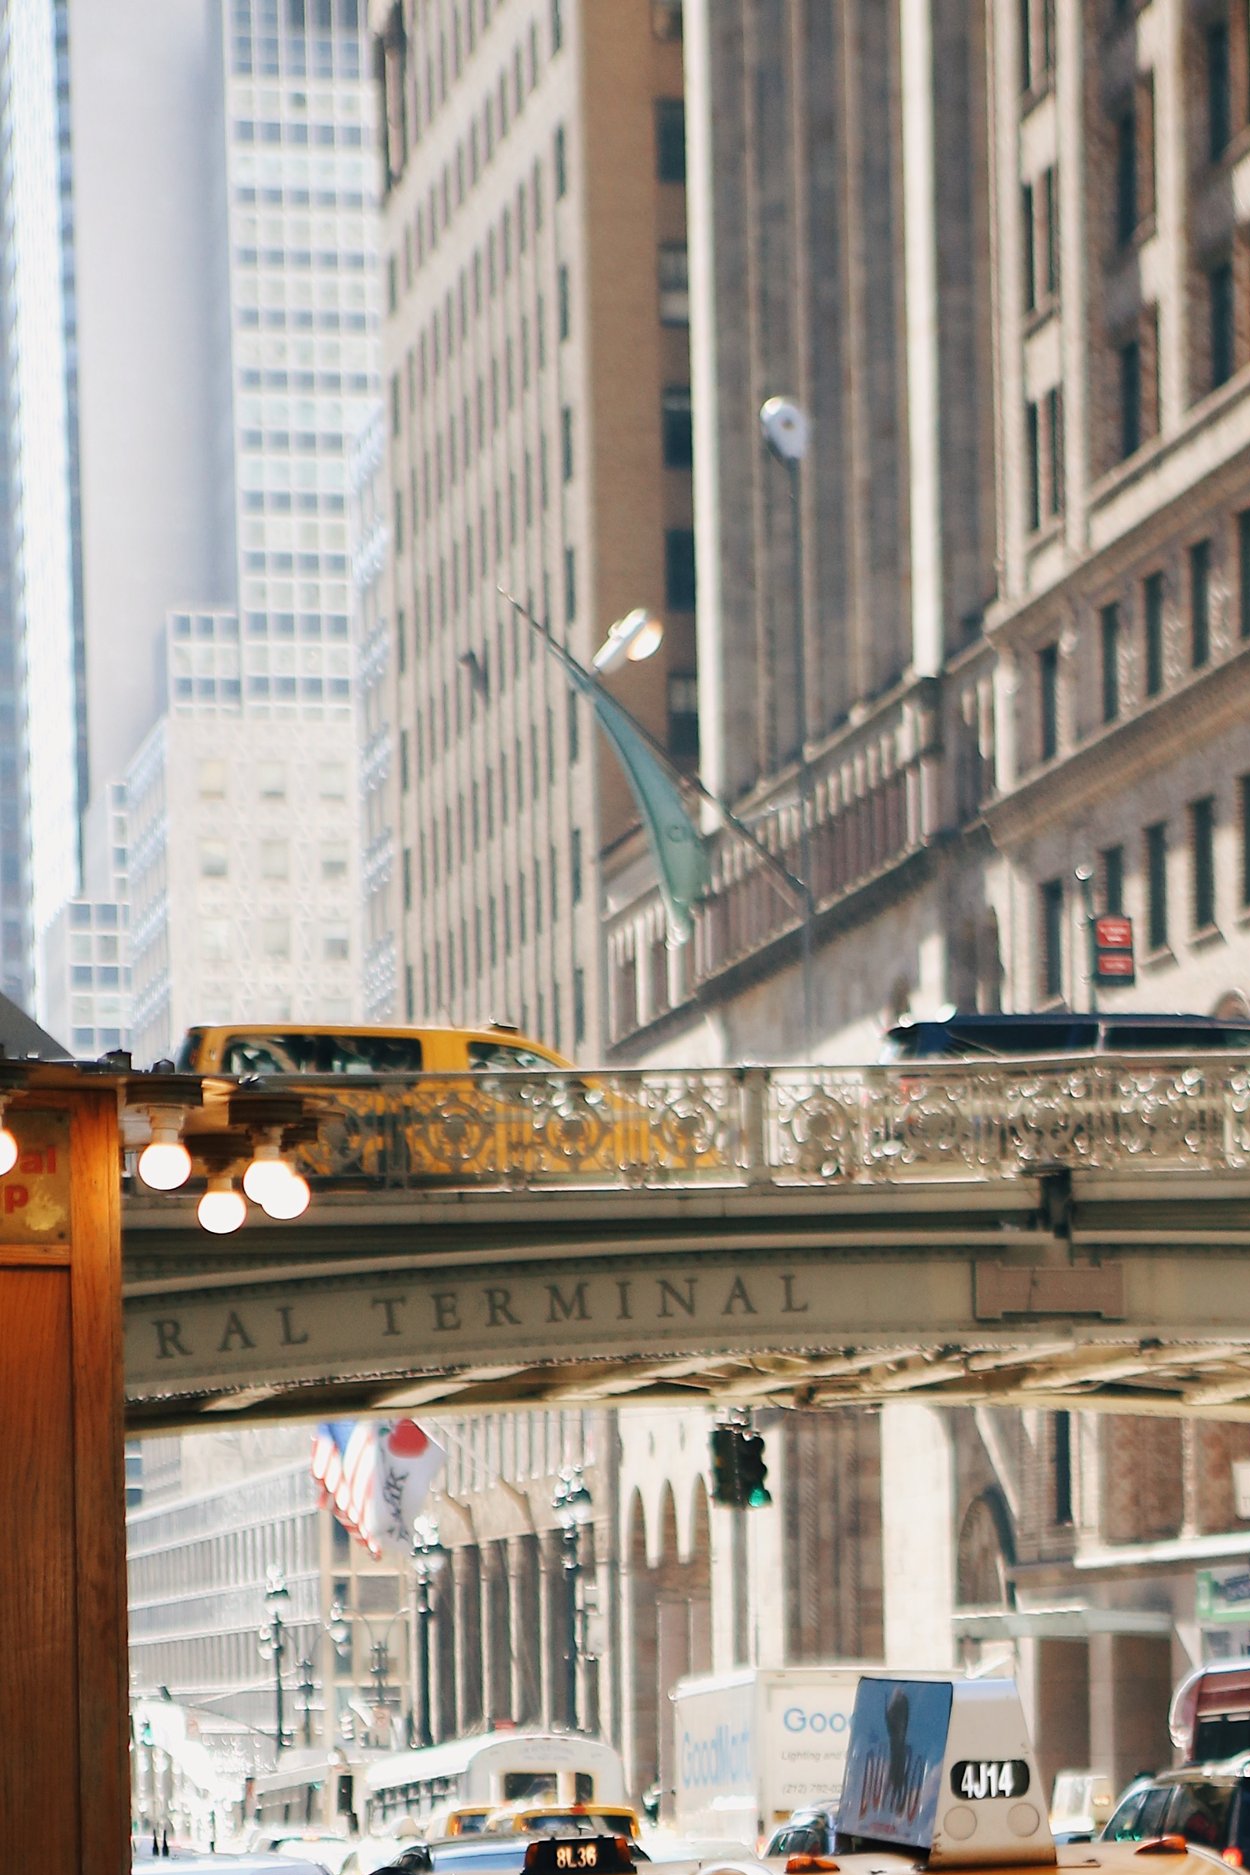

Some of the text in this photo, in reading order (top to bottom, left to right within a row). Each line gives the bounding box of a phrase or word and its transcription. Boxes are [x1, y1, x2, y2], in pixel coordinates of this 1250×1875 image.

[152, 1273, 808, 1359] RAL TERMINAL
[783, 1707, 855, 1732] Goo
[961, 1762, 1014, 1799] 4J14
[556, 1842, 598, 1869] 8L36
